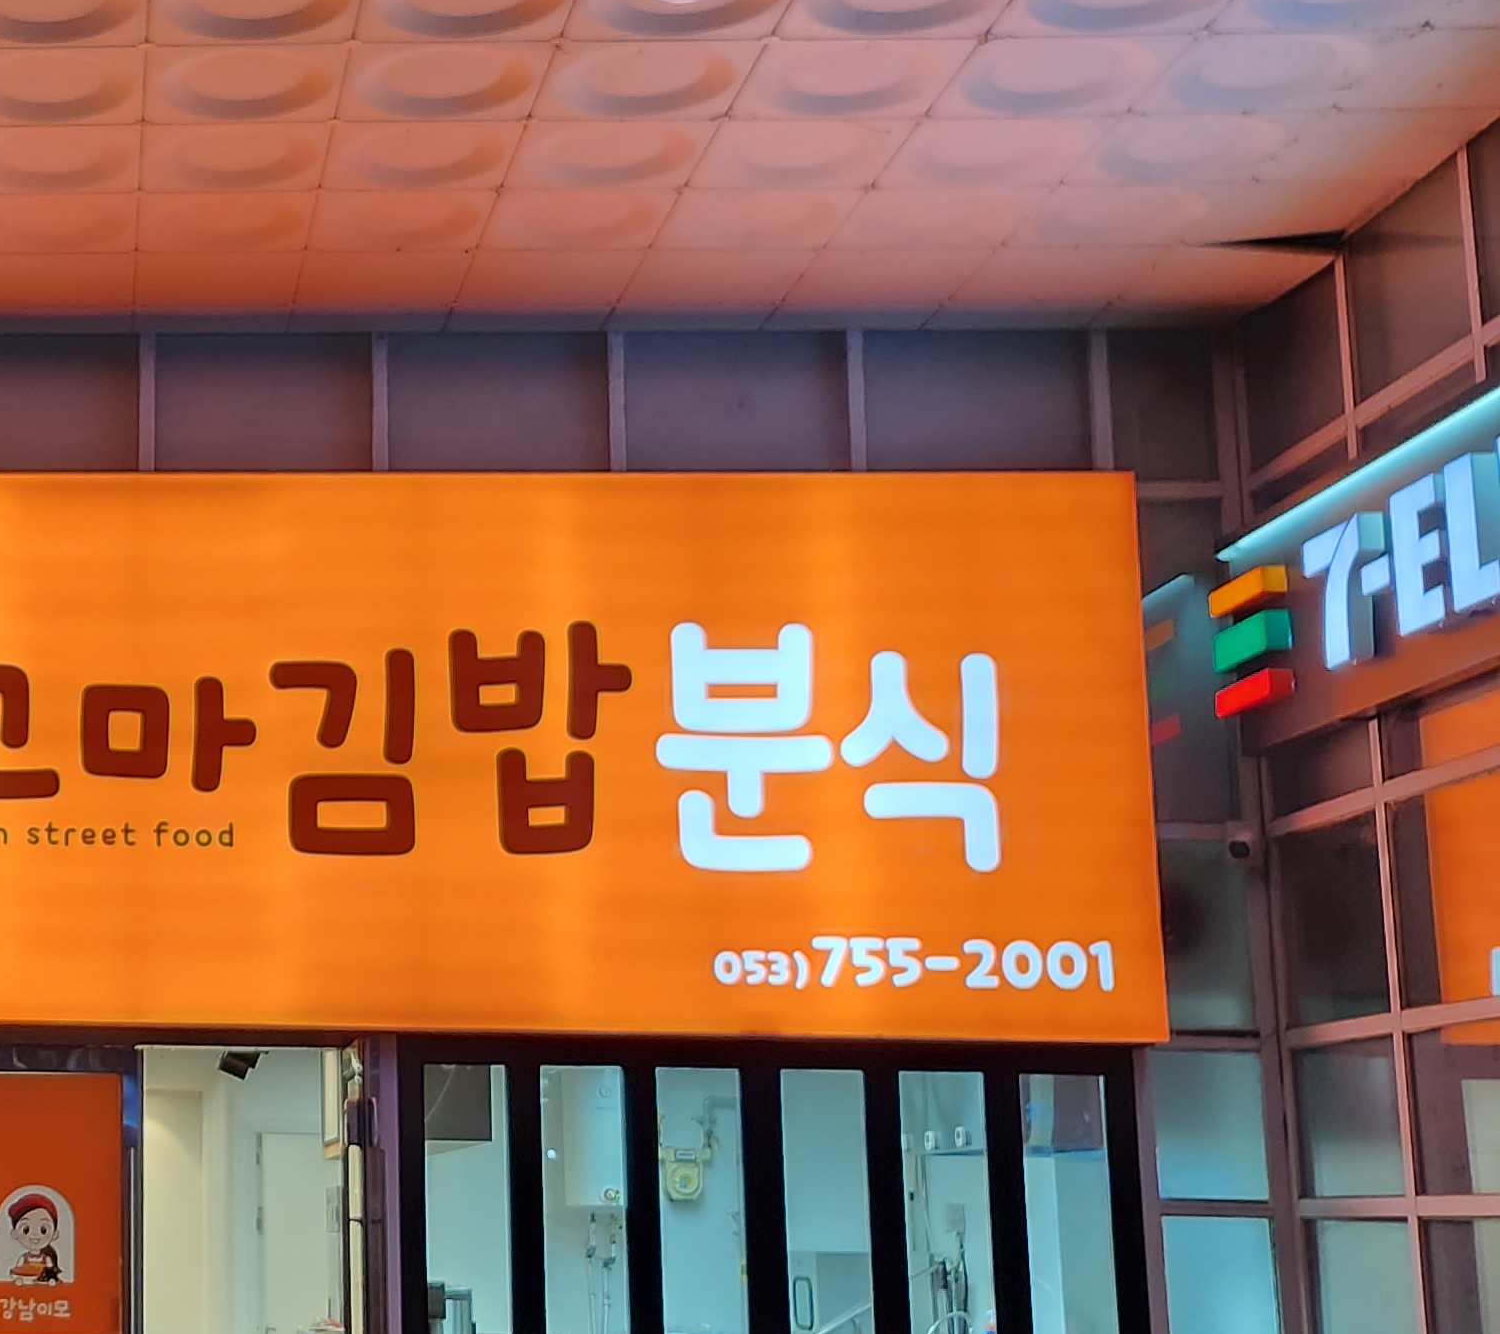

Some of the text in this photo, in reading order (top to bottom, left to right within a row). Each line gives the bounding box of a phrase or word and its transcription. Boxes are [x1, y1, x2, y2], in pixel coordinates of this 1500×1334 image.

[1302, 435, 1500, 672] 7-EL
[26, 821, 137, 848] street
[153, 822, 236, 849] food
